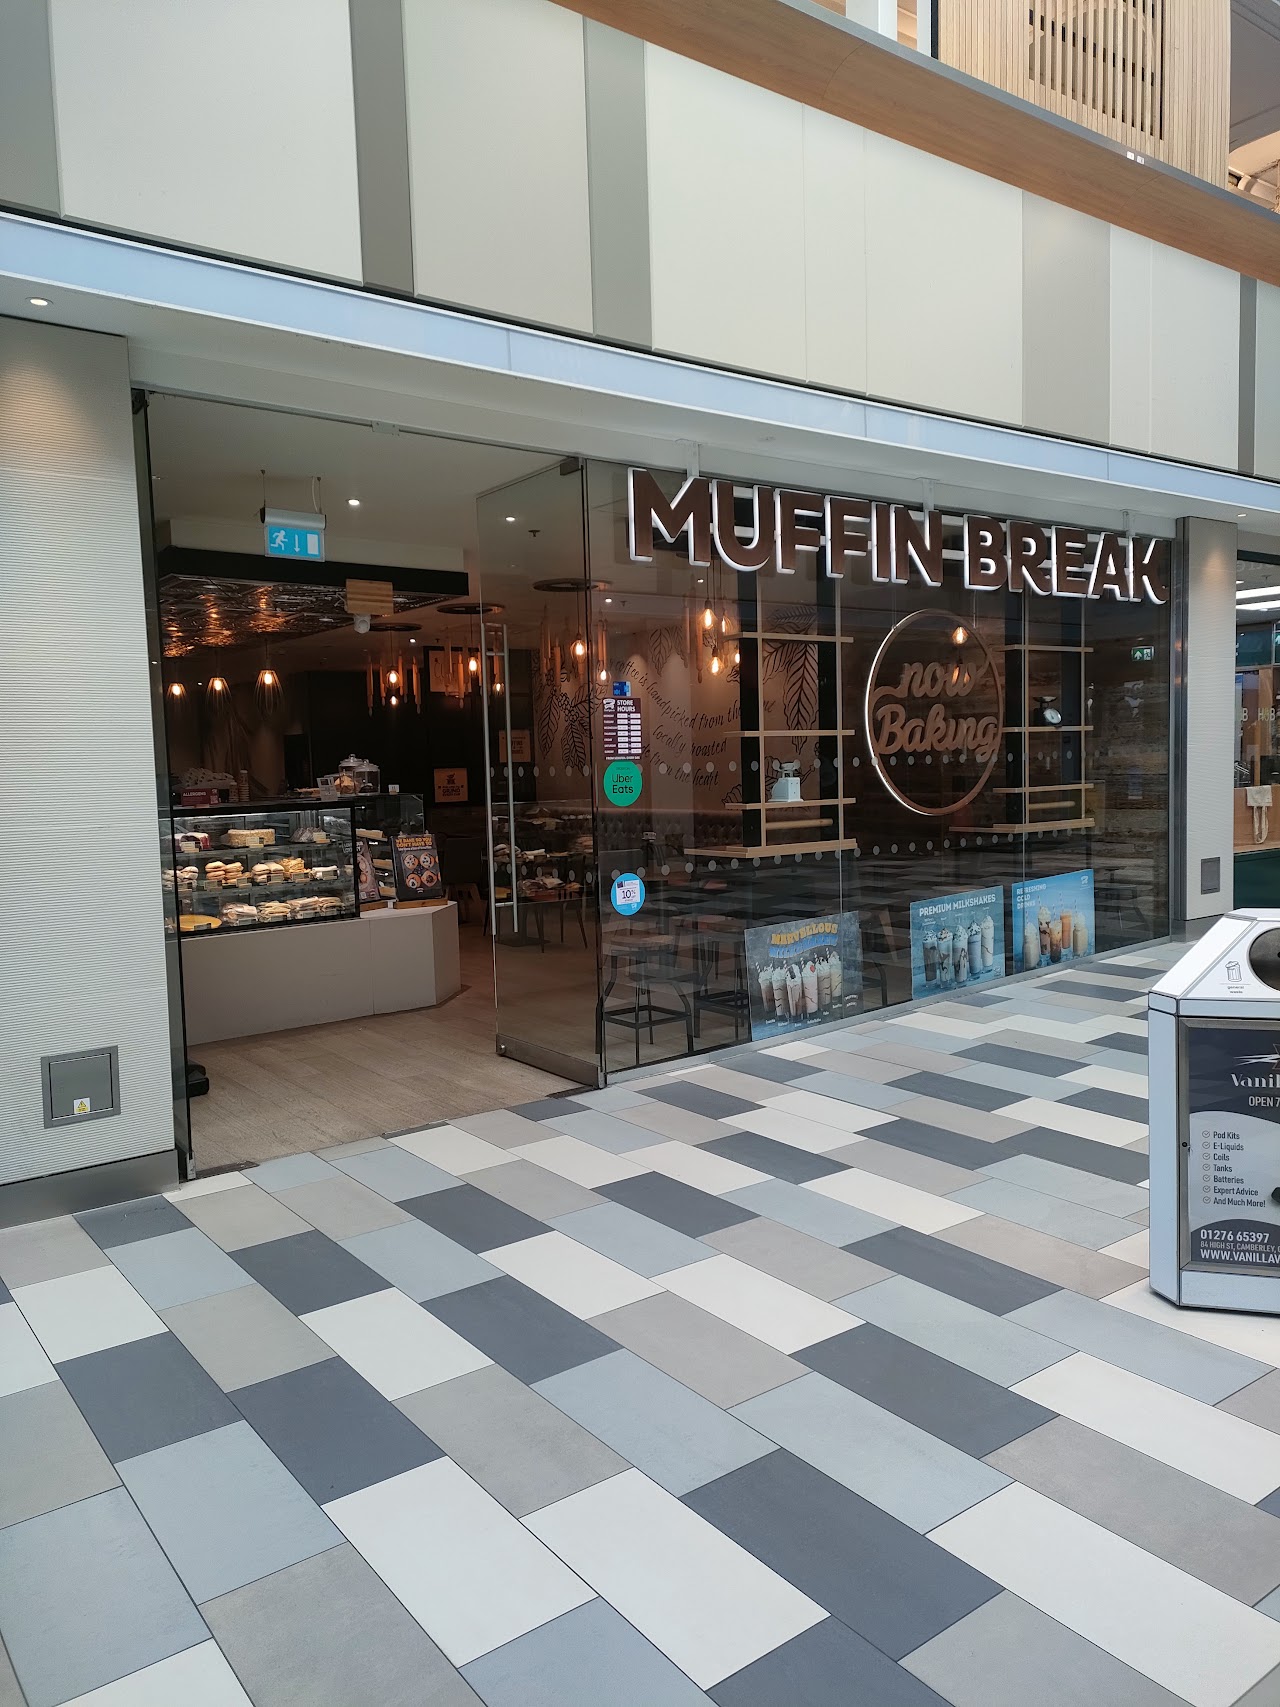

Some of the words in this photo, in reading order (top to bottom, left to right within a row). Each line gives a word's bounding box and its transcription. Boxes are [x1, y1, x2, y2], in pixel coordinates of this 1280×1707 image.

[627, 466, 944, 587] MUFFIN
[963, 513, 1169, 605] BREAK
[874, 661, 984, 698] now
[646, 682, 698, 728] handpicked
[698, 713, 724, 730] from
[876, 703, 998, 763] Baking
[653, 724, 686, 757] locally
[691, 737, 727, 756] roasted
[612, 774, 634, 783] Uber
[612, 784, 634, 794] Eats
[919, 902, 952, 917] PREMIUM
[952, 894, 996, 911] MILKSHAKES
[771, 922, 838, 945] MARVELLOUS
[1248, 1096, 1273, 1107] OPEN
[1275, 1097, 1280, 1107] 7
[1213, 1131, 1226, 1139] Pod
[1227, 1132, 1240, 1140] Kits
[1213, 1142, 1244, 1152] E-Liquids
[1213, 1153, 1230, 1161] Coils
[1213, 1164, 1233, 1172] Tanks
[1213, 1175, 1244, 1184] Batteries
[1213, 1186, 1235, 1195] Expert
[1235, 1187, 1258, 1196] Advice
[1213, 1197, 1226, 1205] And
[1227, 1197, 1246, 1206] Much
[1246, 1199, 1266, 1207] More!
[1200, 1229, 1234, 1241] 01276
[1236, 1231, 1270, 1243] 65397
[1209, 1241, 1225, 1249] HIGH
[1226, 1242, 1236, 1251] ST,
[1236, 1243, 1277, 1253] CAMBERLEY,
